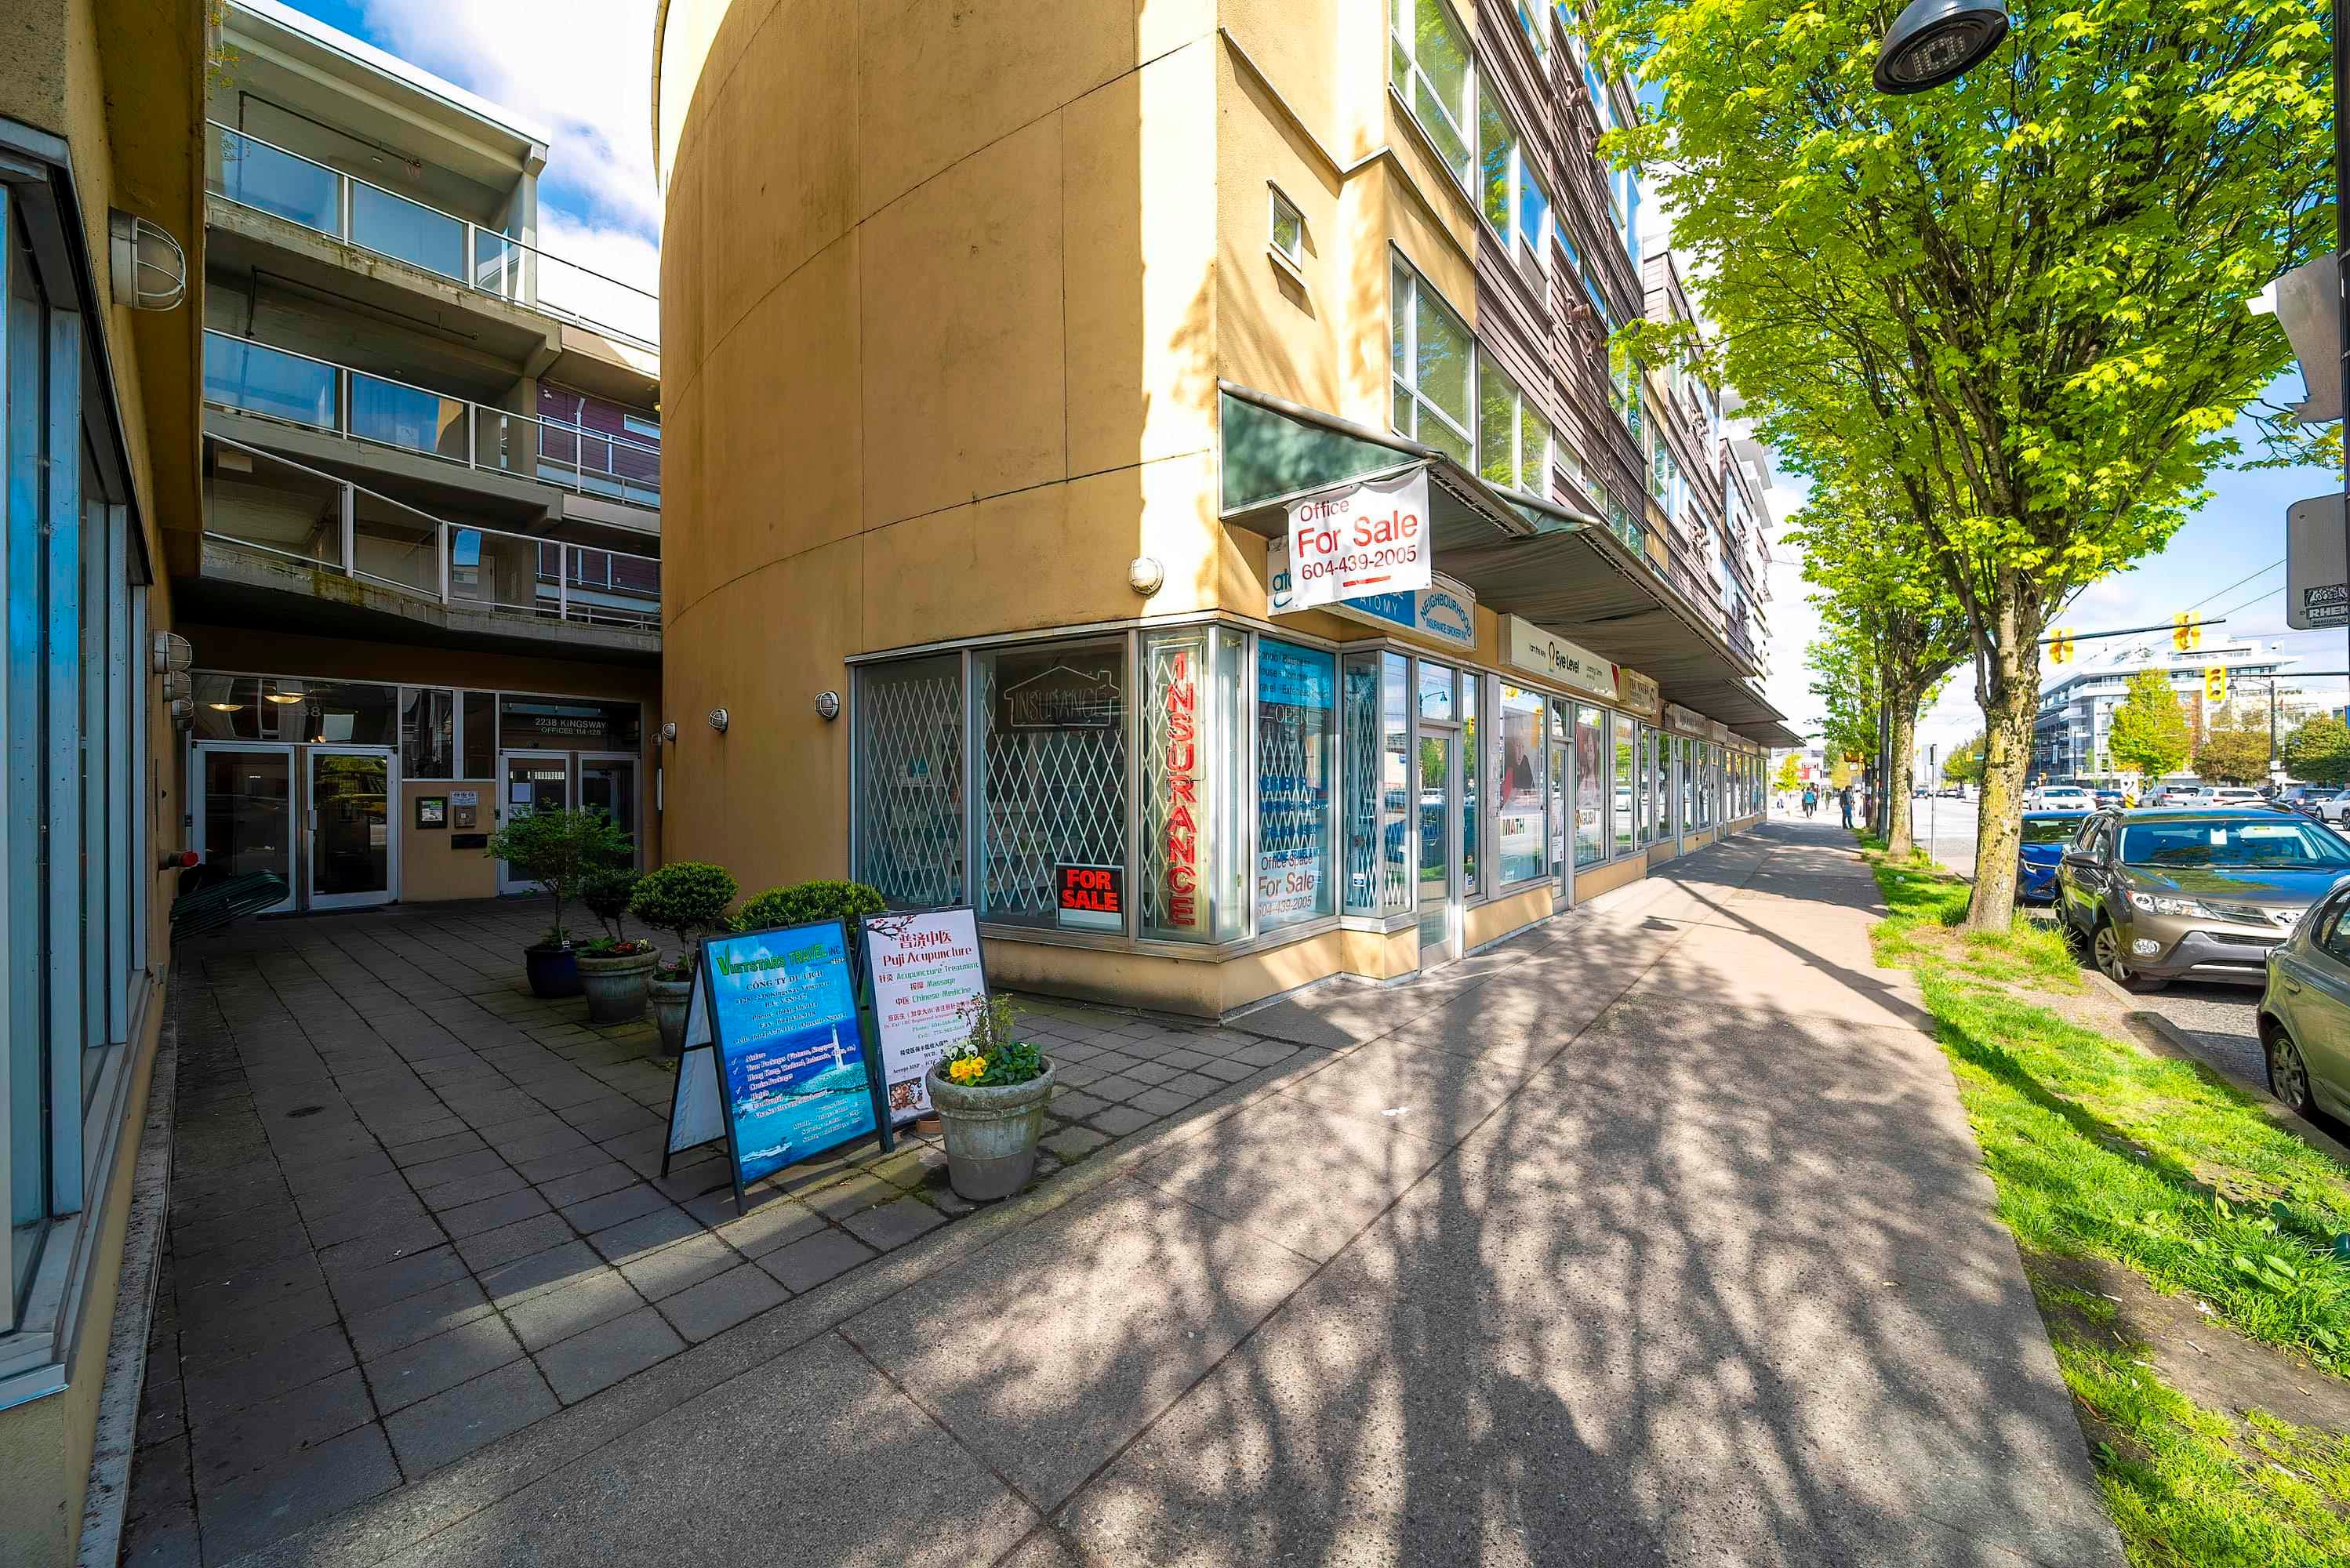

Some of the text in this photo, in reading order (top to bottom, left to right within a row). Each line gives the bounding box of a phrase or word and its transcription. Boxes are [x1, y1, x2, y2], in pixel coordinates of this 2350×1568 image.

[1300, 500, 1349, 521] Office
[1298, 510, 1418, 557] For Sale
[1302, 545, 1417, 580] 604-439-2005
[1420, 593, 1472, 637] NEIGHBOURHOOD
[1556, 650, 1566, 670] Eye
[1566, 654, 1580, 674] Level
[1015, 688, 1106, 721] INSURANCE
[1275, 704, 1309, 725] OPEN
[561, 719, 607, 728] KINGSWAY
[1166, 652, 1197, 927] INSURANCE
[1261, 854, 1313, 870] Office Space
[1066, 869, 1111, 890] FOR
[1259, 870, 1315, 897] For Sale
[1062, 889, 1117, 912] SALE
[899, 929, 952, 949] 普济中医
[716, 943, 841, 975] VIETSTARS TRAVEL INC
[883, 946, 972, 967] Puji Acupuncture
[775, 977, 786, 986] TY
[896, 966, 943, 980] Acupuncture
[944, 962, 979, 973] Treatment
[927, 977, 956, 989] Massage
[895, 986, 972, 1006] 中医 Chinese Medicine
